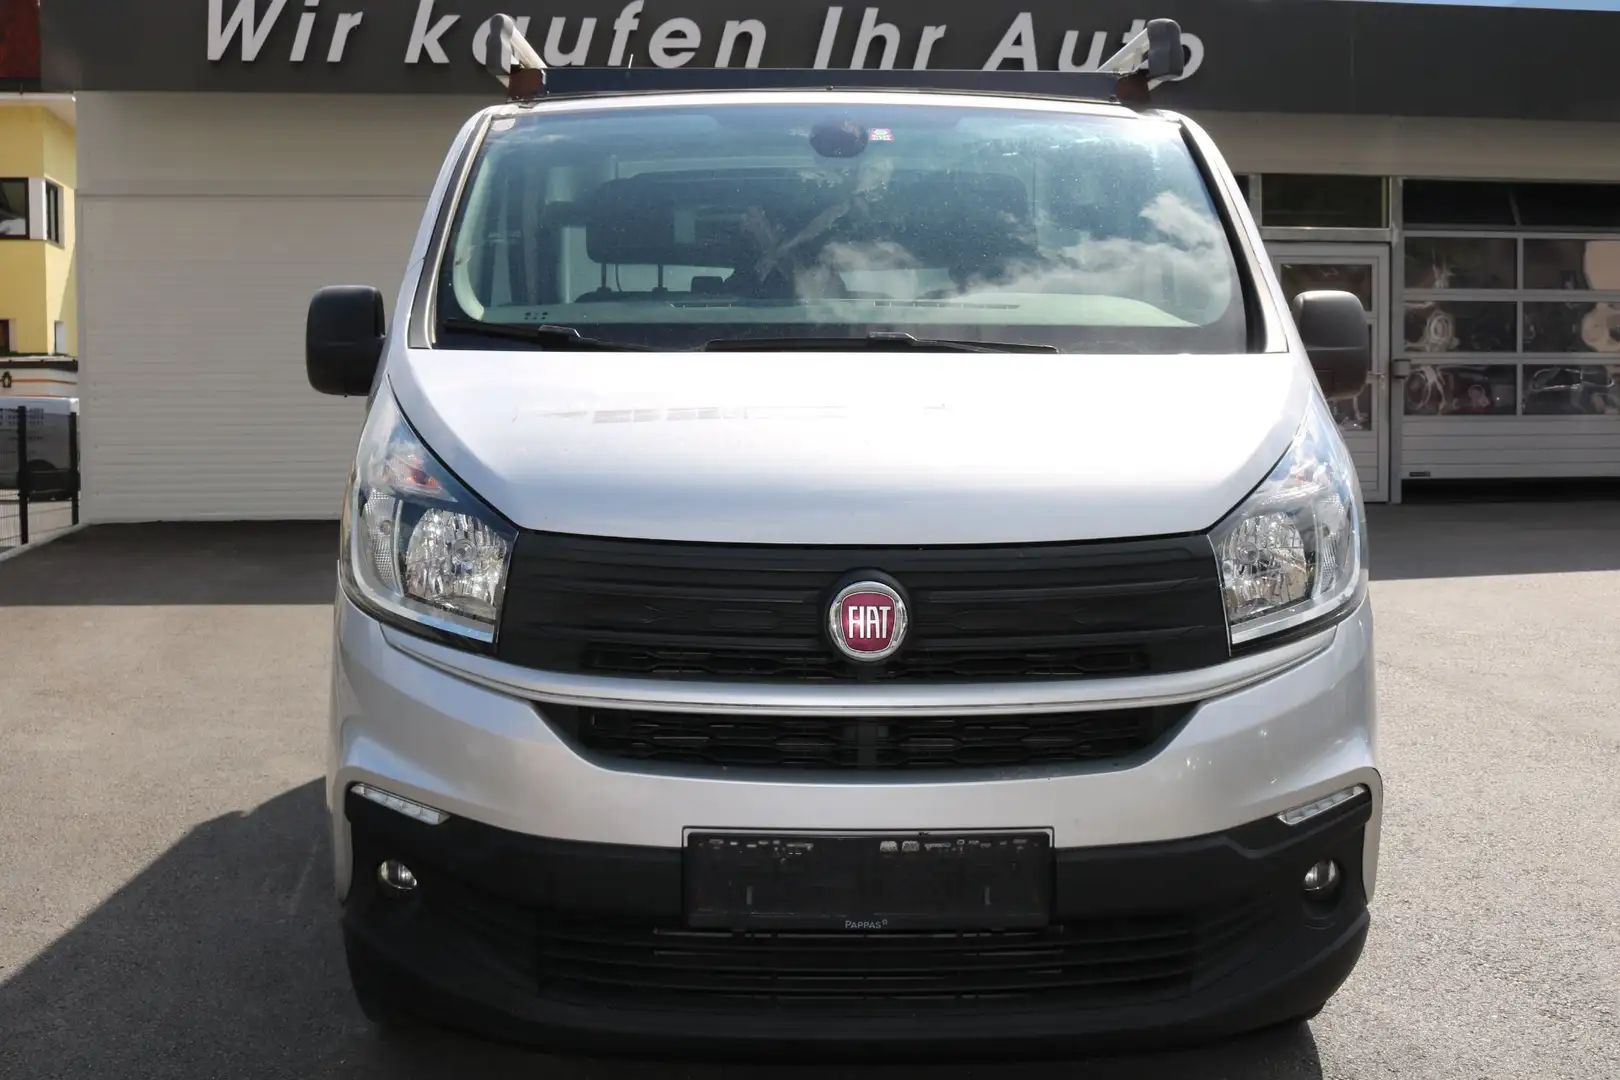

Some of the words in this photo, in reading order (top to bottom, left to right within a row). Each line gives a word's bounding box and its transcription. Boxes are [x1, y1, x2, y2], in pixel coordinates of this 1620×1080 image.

[207, 0, 363, 62] Wir
[813, 6, 946, 70] Ihr
[848, 606, 891, 639] FIAT
